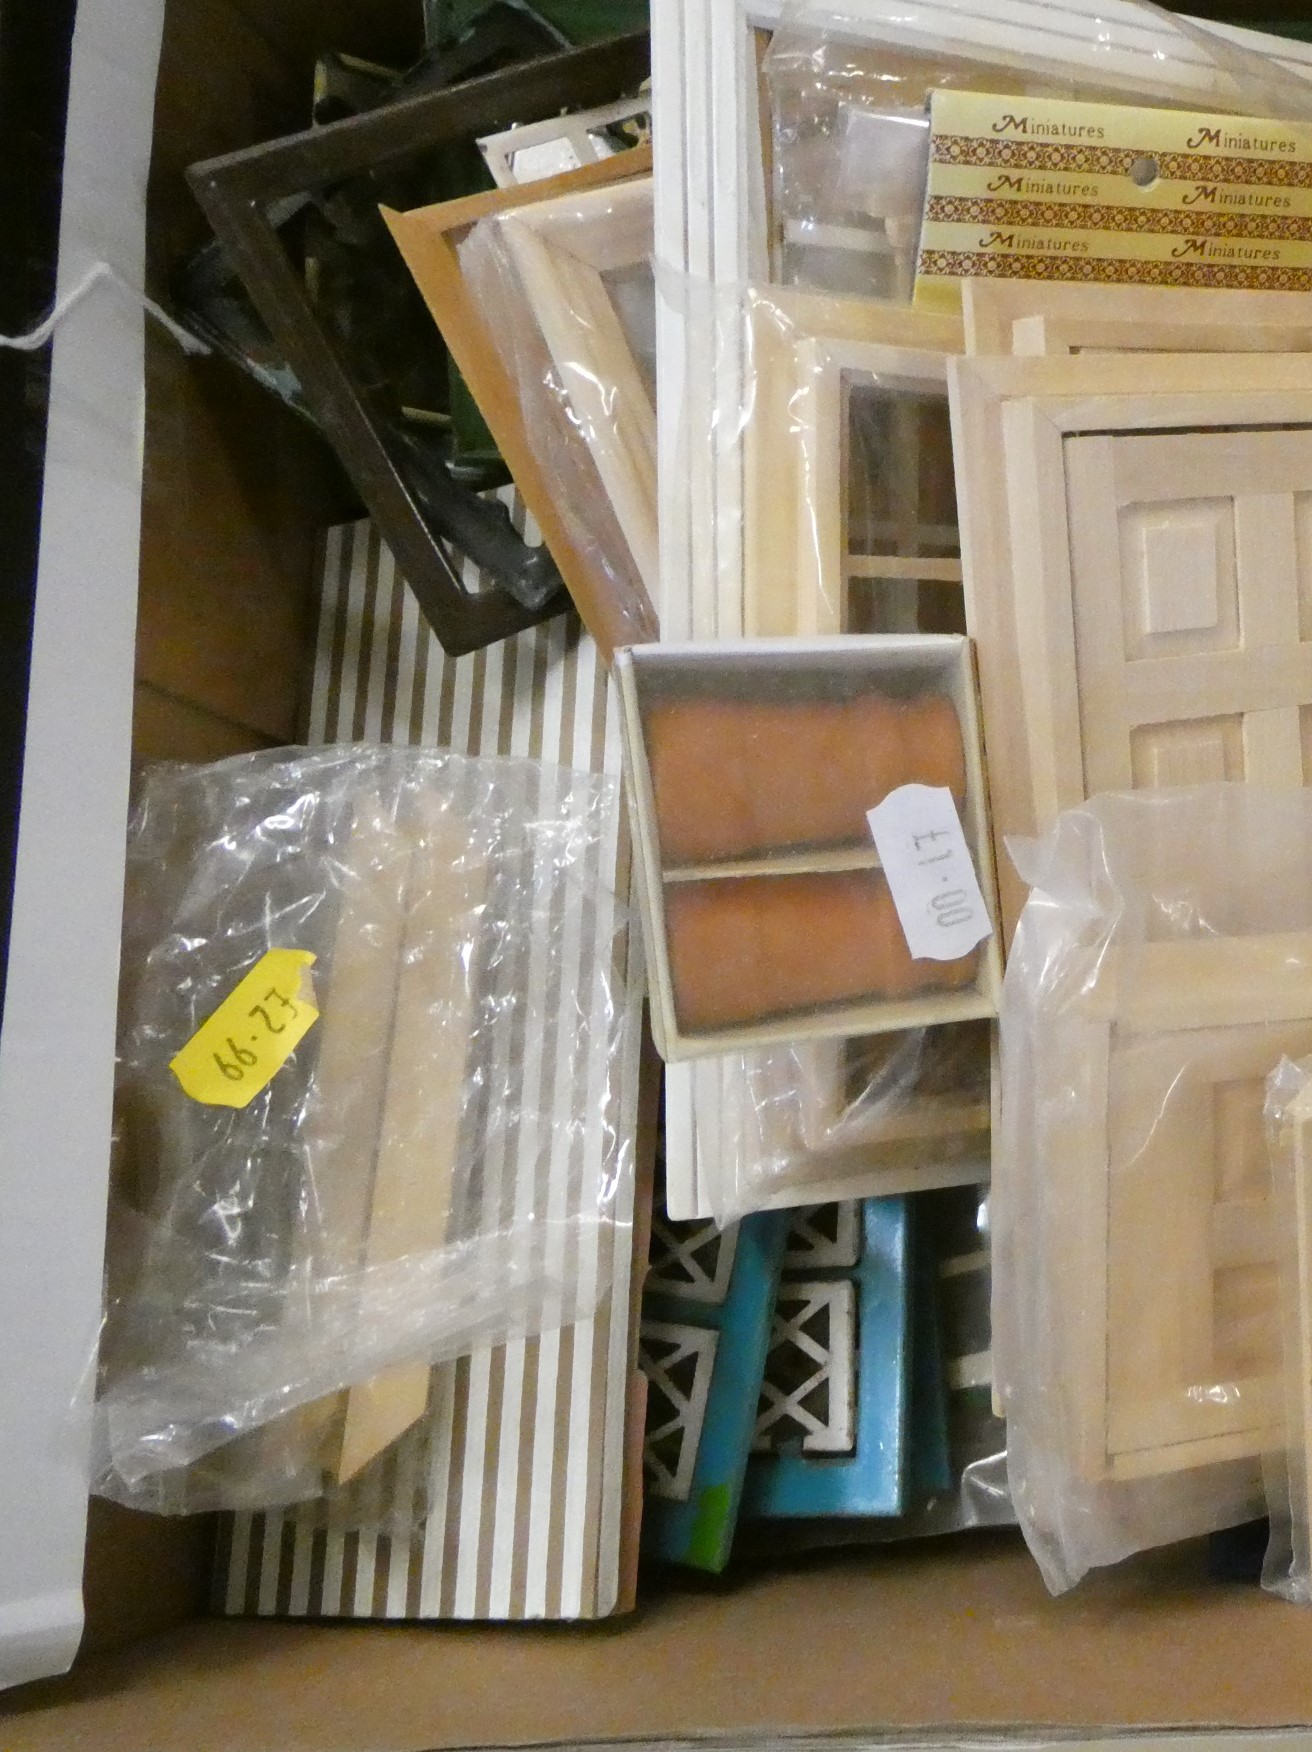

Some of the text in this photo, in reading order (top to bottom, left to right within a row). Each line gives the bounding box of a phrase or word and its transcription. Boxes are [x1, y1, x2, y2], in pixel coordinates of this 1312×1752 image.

[992, 114, 1105, 139] Miniatures
[1186, 127, 1297, 153] Miniatures
[987, 173, 1099, 197] Miniatures
[1182, 184, 1292, 208] Miniatures
[978, 230, 1091, 252] Miniatures
[1171, 238, 1281, 260] Miniatures
[913, 831, 973, 927] £1.00
[214, 987, 298, 1081] £2.99
